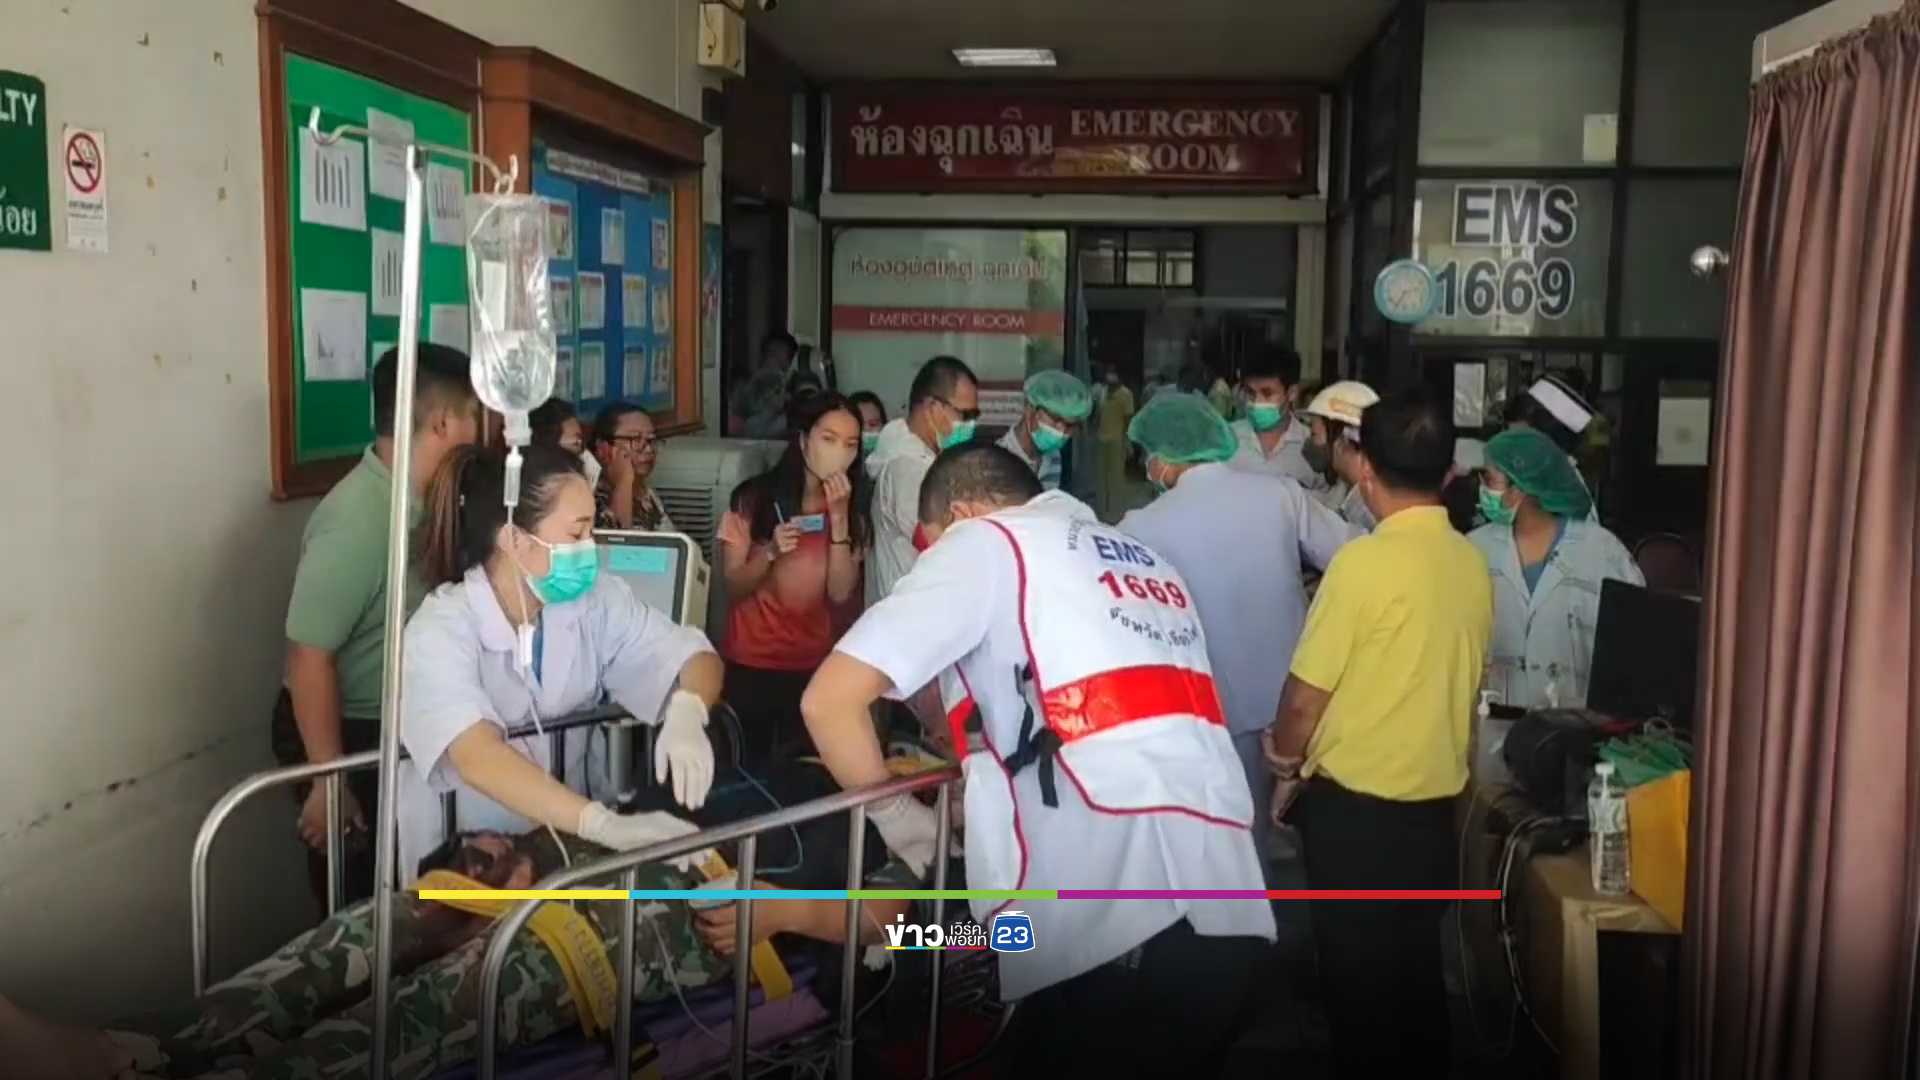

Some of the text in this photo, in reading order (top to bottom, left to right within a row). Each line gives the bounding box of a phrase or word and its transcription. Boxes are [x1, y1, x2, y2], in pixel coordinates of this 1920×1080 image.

[851, 105, 1054, 175] ห้องฉุกเฉิน
[1070, 109, 1299, 138] EMERGENCY
[1127, 143, 1241, 174] ROOM
[1453, 183, 1578, 248] EMS
[1435, 257, 1576, 320] 1669
[869, 311, 1025, 329] EMERGENCY ROOM
[1092, 534, 1156, 568] EMS
[1098, 570, 1188, 610] 1669
